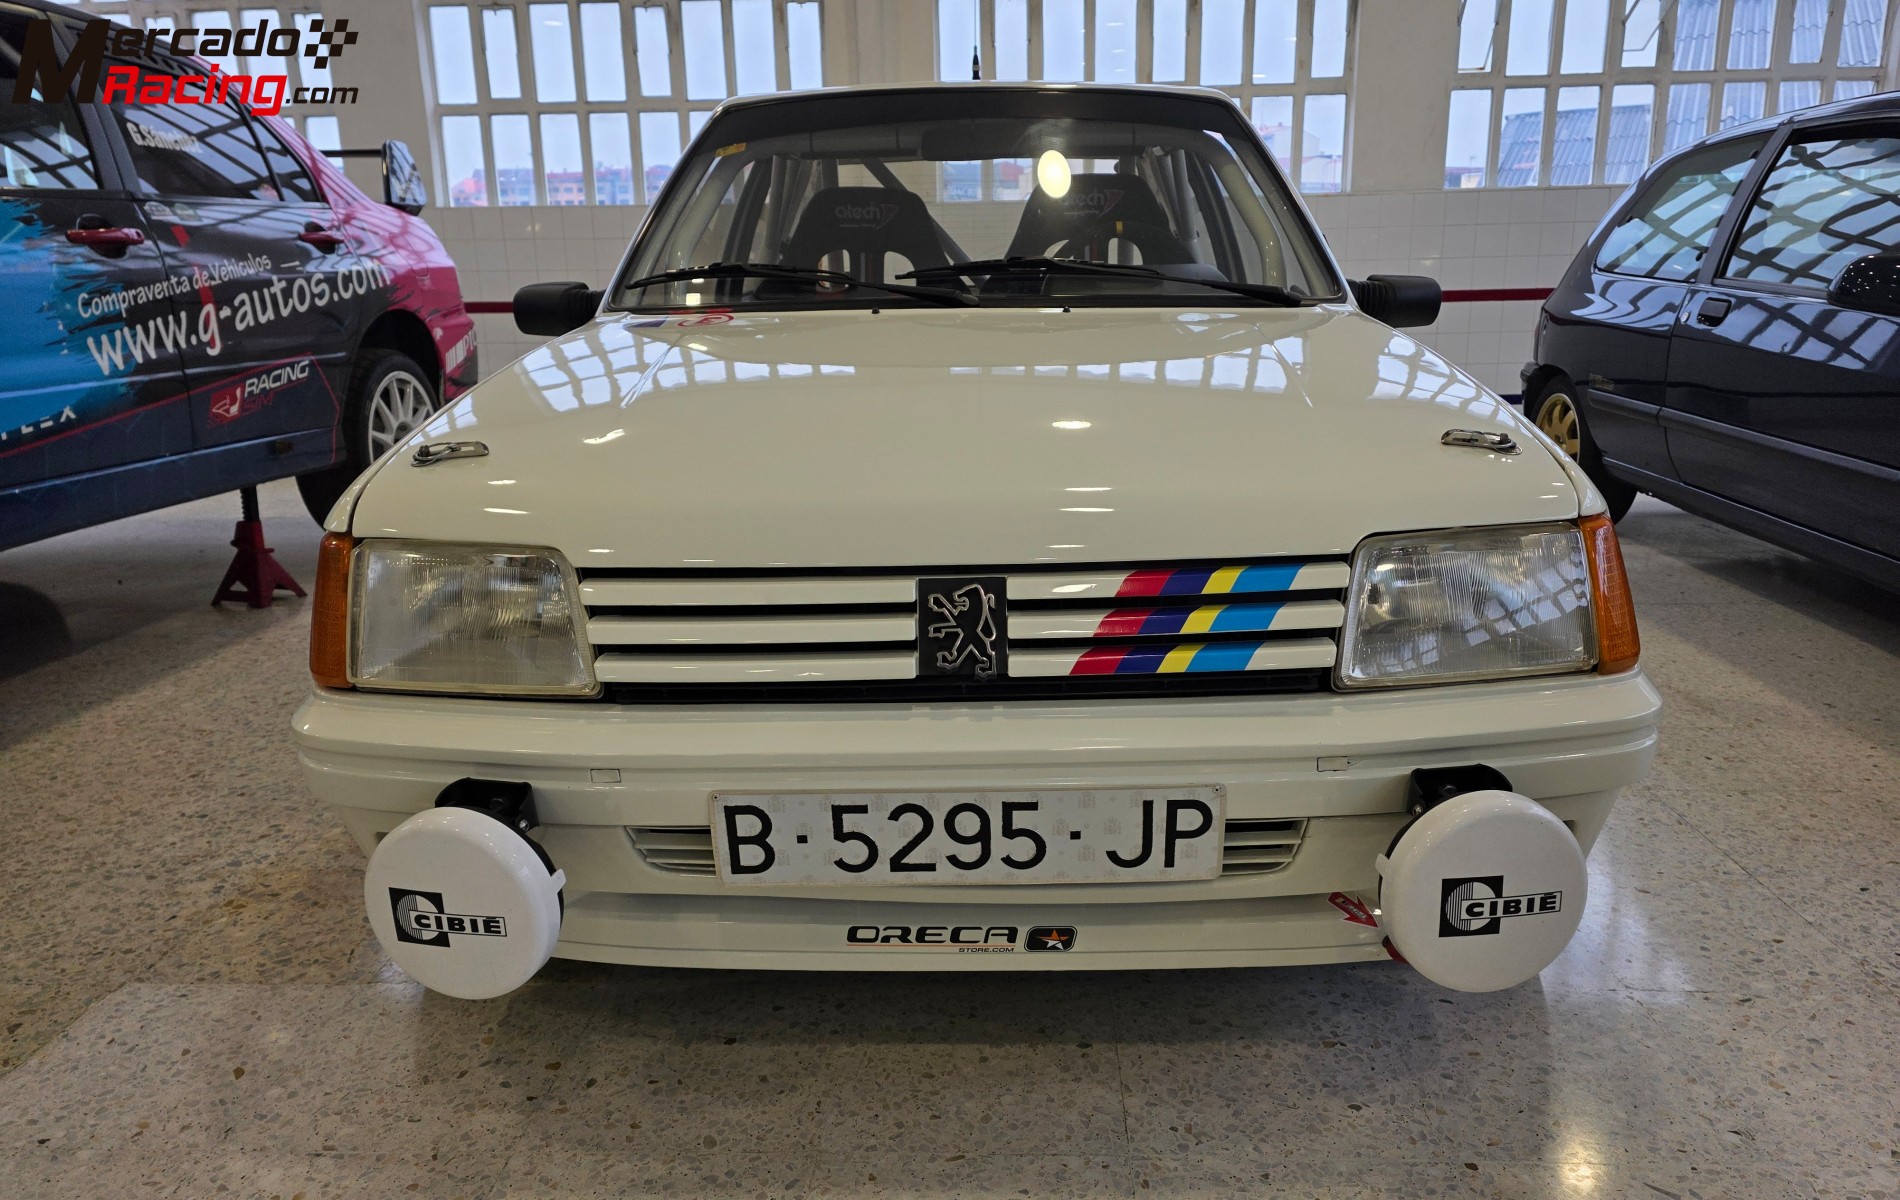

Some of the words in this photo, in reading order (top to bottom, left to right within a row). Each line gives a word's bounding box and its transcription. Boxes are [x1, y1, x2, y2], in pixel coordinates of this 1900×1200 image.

[835, 202, 881, 219] atech
[78, 274, 191, 318] Compraventa
[192, 266, 211, 290] de
[87, 257, 391, 376] www.g-autos.com
[244, 360, 310, 398] RACING
[846, 925, 1019, 944] ORECA
